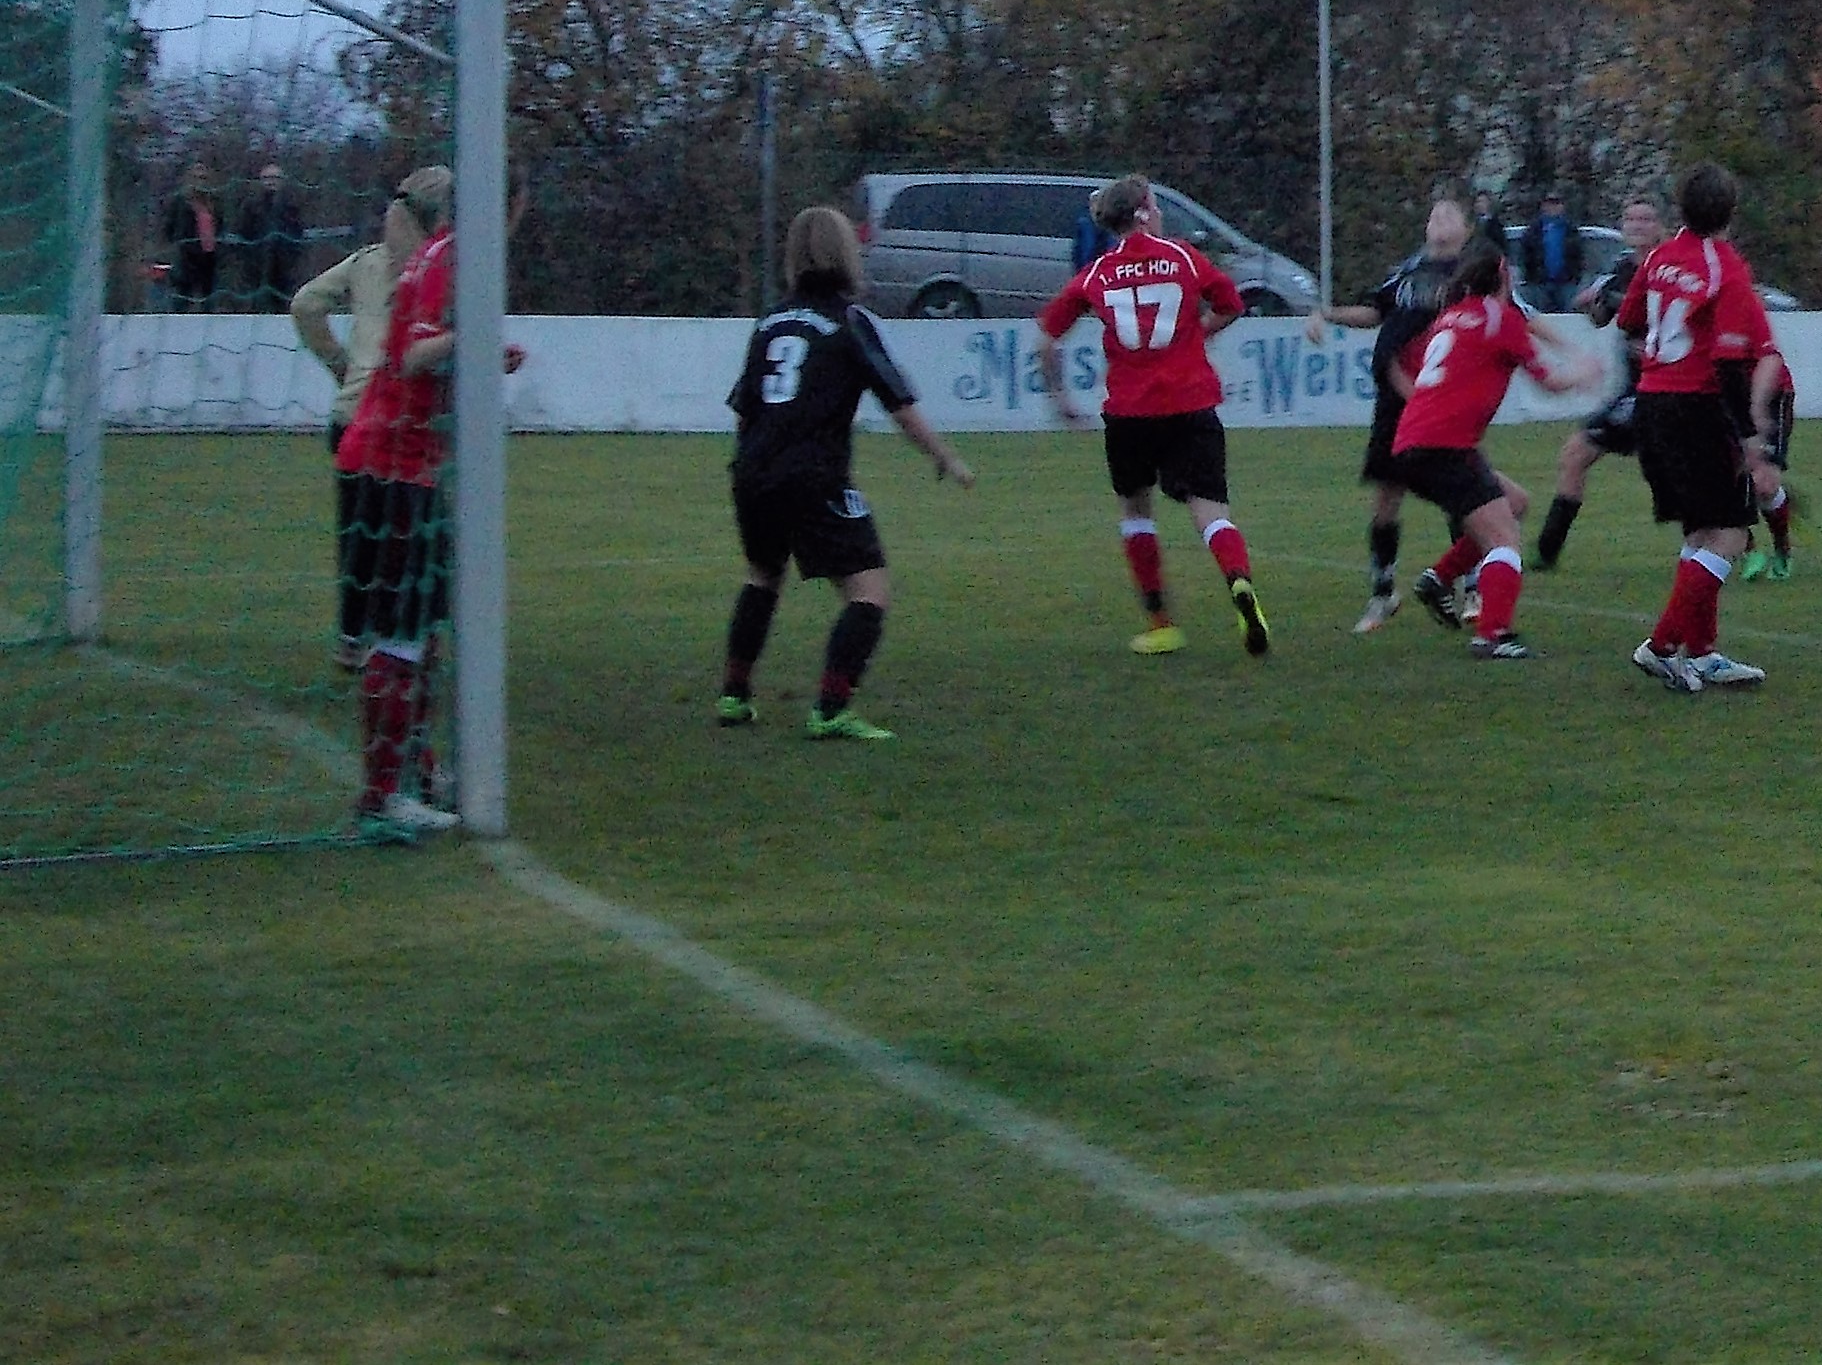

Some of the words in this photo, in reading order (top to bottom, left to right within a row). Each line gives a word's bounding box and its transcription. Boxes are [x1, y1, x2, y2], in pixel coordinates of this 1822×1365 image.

[1115, 262, 1144, 280] FFC
[1102, 282, 1184, 351] 17
[761, 335, 810, 404] 3
[1238, 329, 1378, 416] Weis
[1413, 328, 1458, 388] 2
